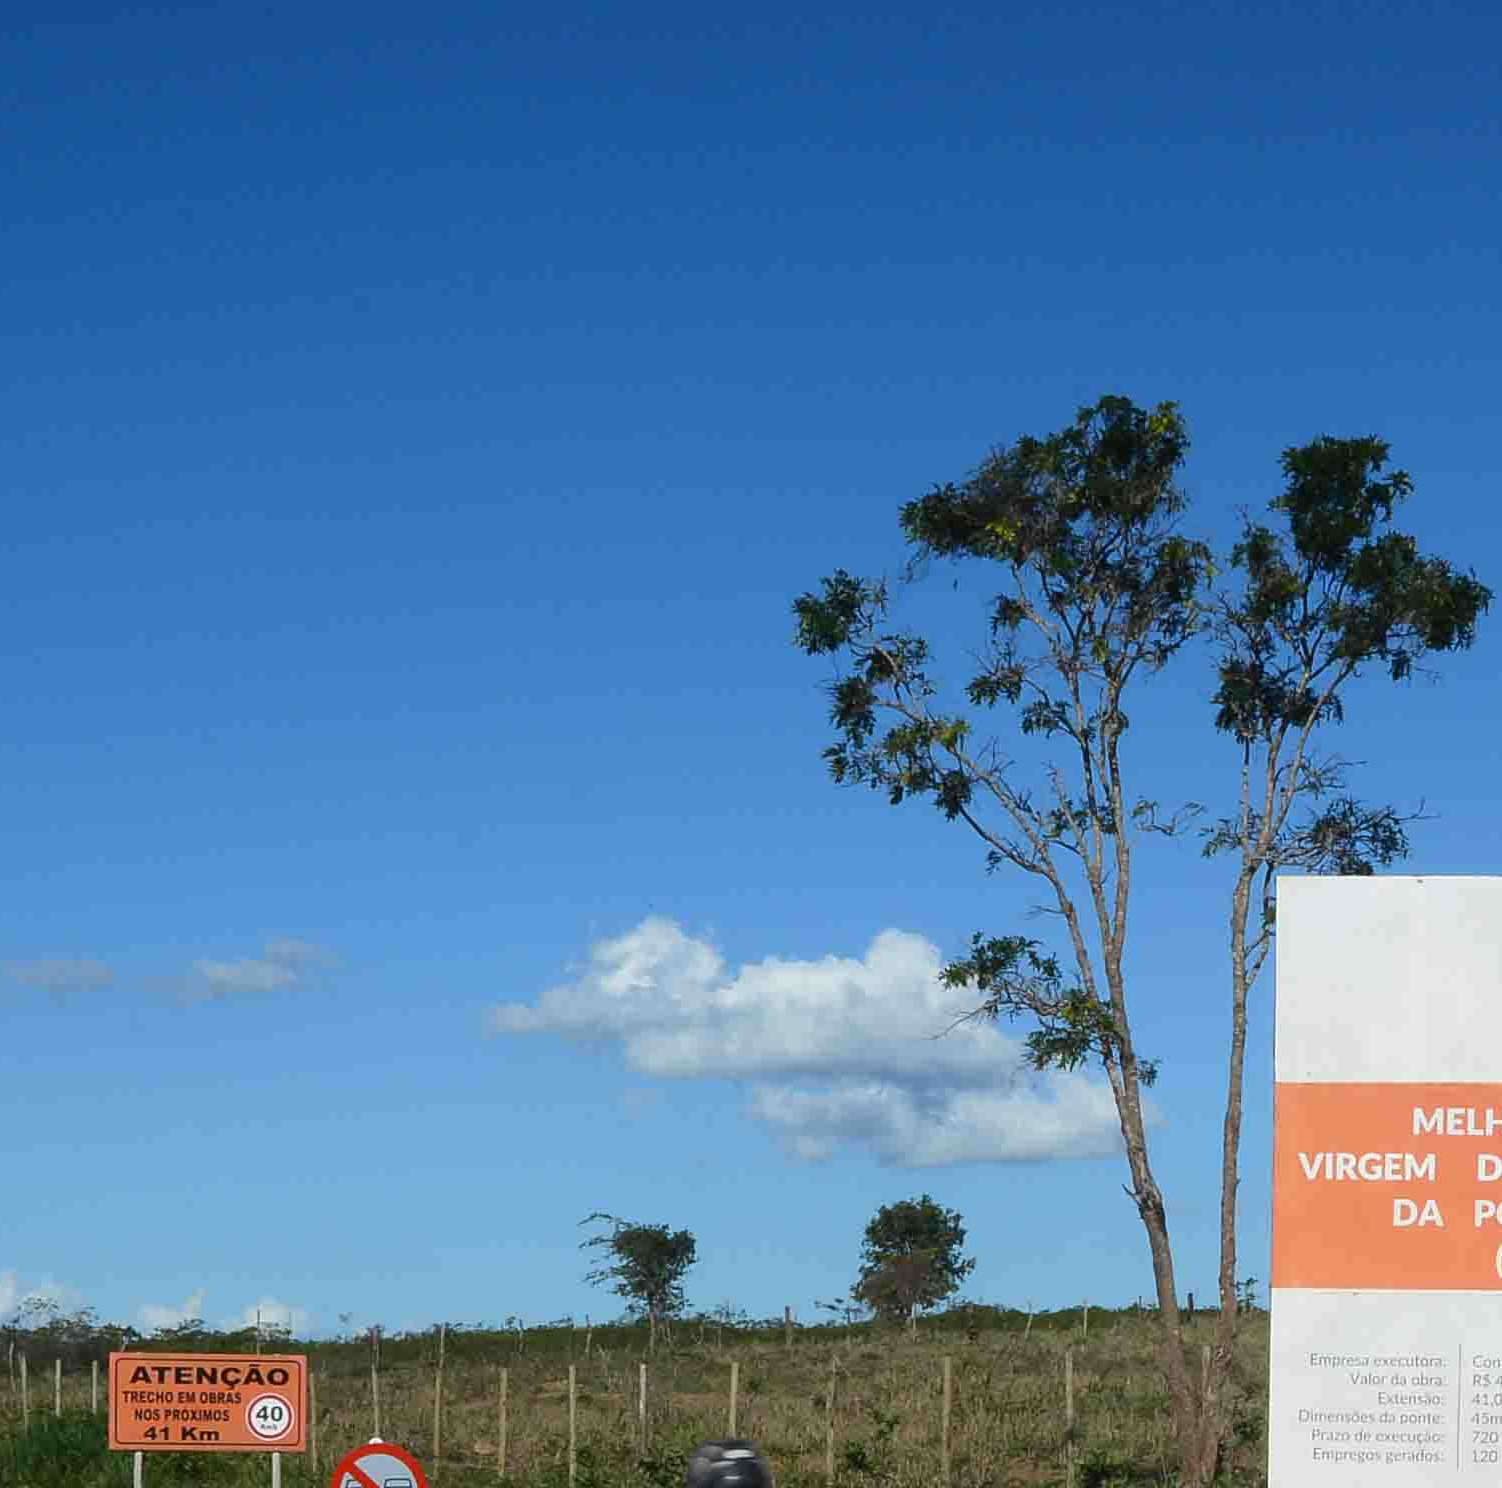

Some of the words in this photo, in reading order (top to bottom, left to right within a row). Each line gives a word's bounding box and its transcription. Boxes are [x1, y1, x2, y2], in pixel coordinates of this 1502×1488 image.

[1297, 1151, 1436, 1182] VIRGEM
[1392, 1198, 1445, 1228] DA
[1309, 1352, 1370, 1369] Empresa
[129, 1364, 290, 1390] ATENÇÃO
[1350, 1372, 1387, 1386] Valor
[1390, 1374, 1407, 1386] da
[1472, 1374, 1491, 1387] R$
[121, 1391, 174, 1404] TRECHO
[177, 1391, 196, 1403] EM
[199, 1392, 242, 1404] OBRAS
[1377, 1391, 1446, 1406] Extensão:
[134, 1408, 161, 1421] NOS
[256, 1405, 284, 1422] 40
[1297, 1409, 1375, 1424] Dimensões
[1379, 1411, 1396, 1423] da
[1399, 1412, 1446, 1426] ponte:
[1471, 1412, 1502, 1425] 45m
[143, 1426, 170, 1441] 41
[181, 1426, 219, 1441] Km
[1311, 1428, 1351, 1441] Prazo
[1354, 1429, 1372, 1442] de
[1375, 1430, 1446, 1444] execução:
[1472, 1431, 1499, 1444] 720
[1312, 1447, 1381, 1463] Empregos
[1472, 1450, 1498, 1463] 120
